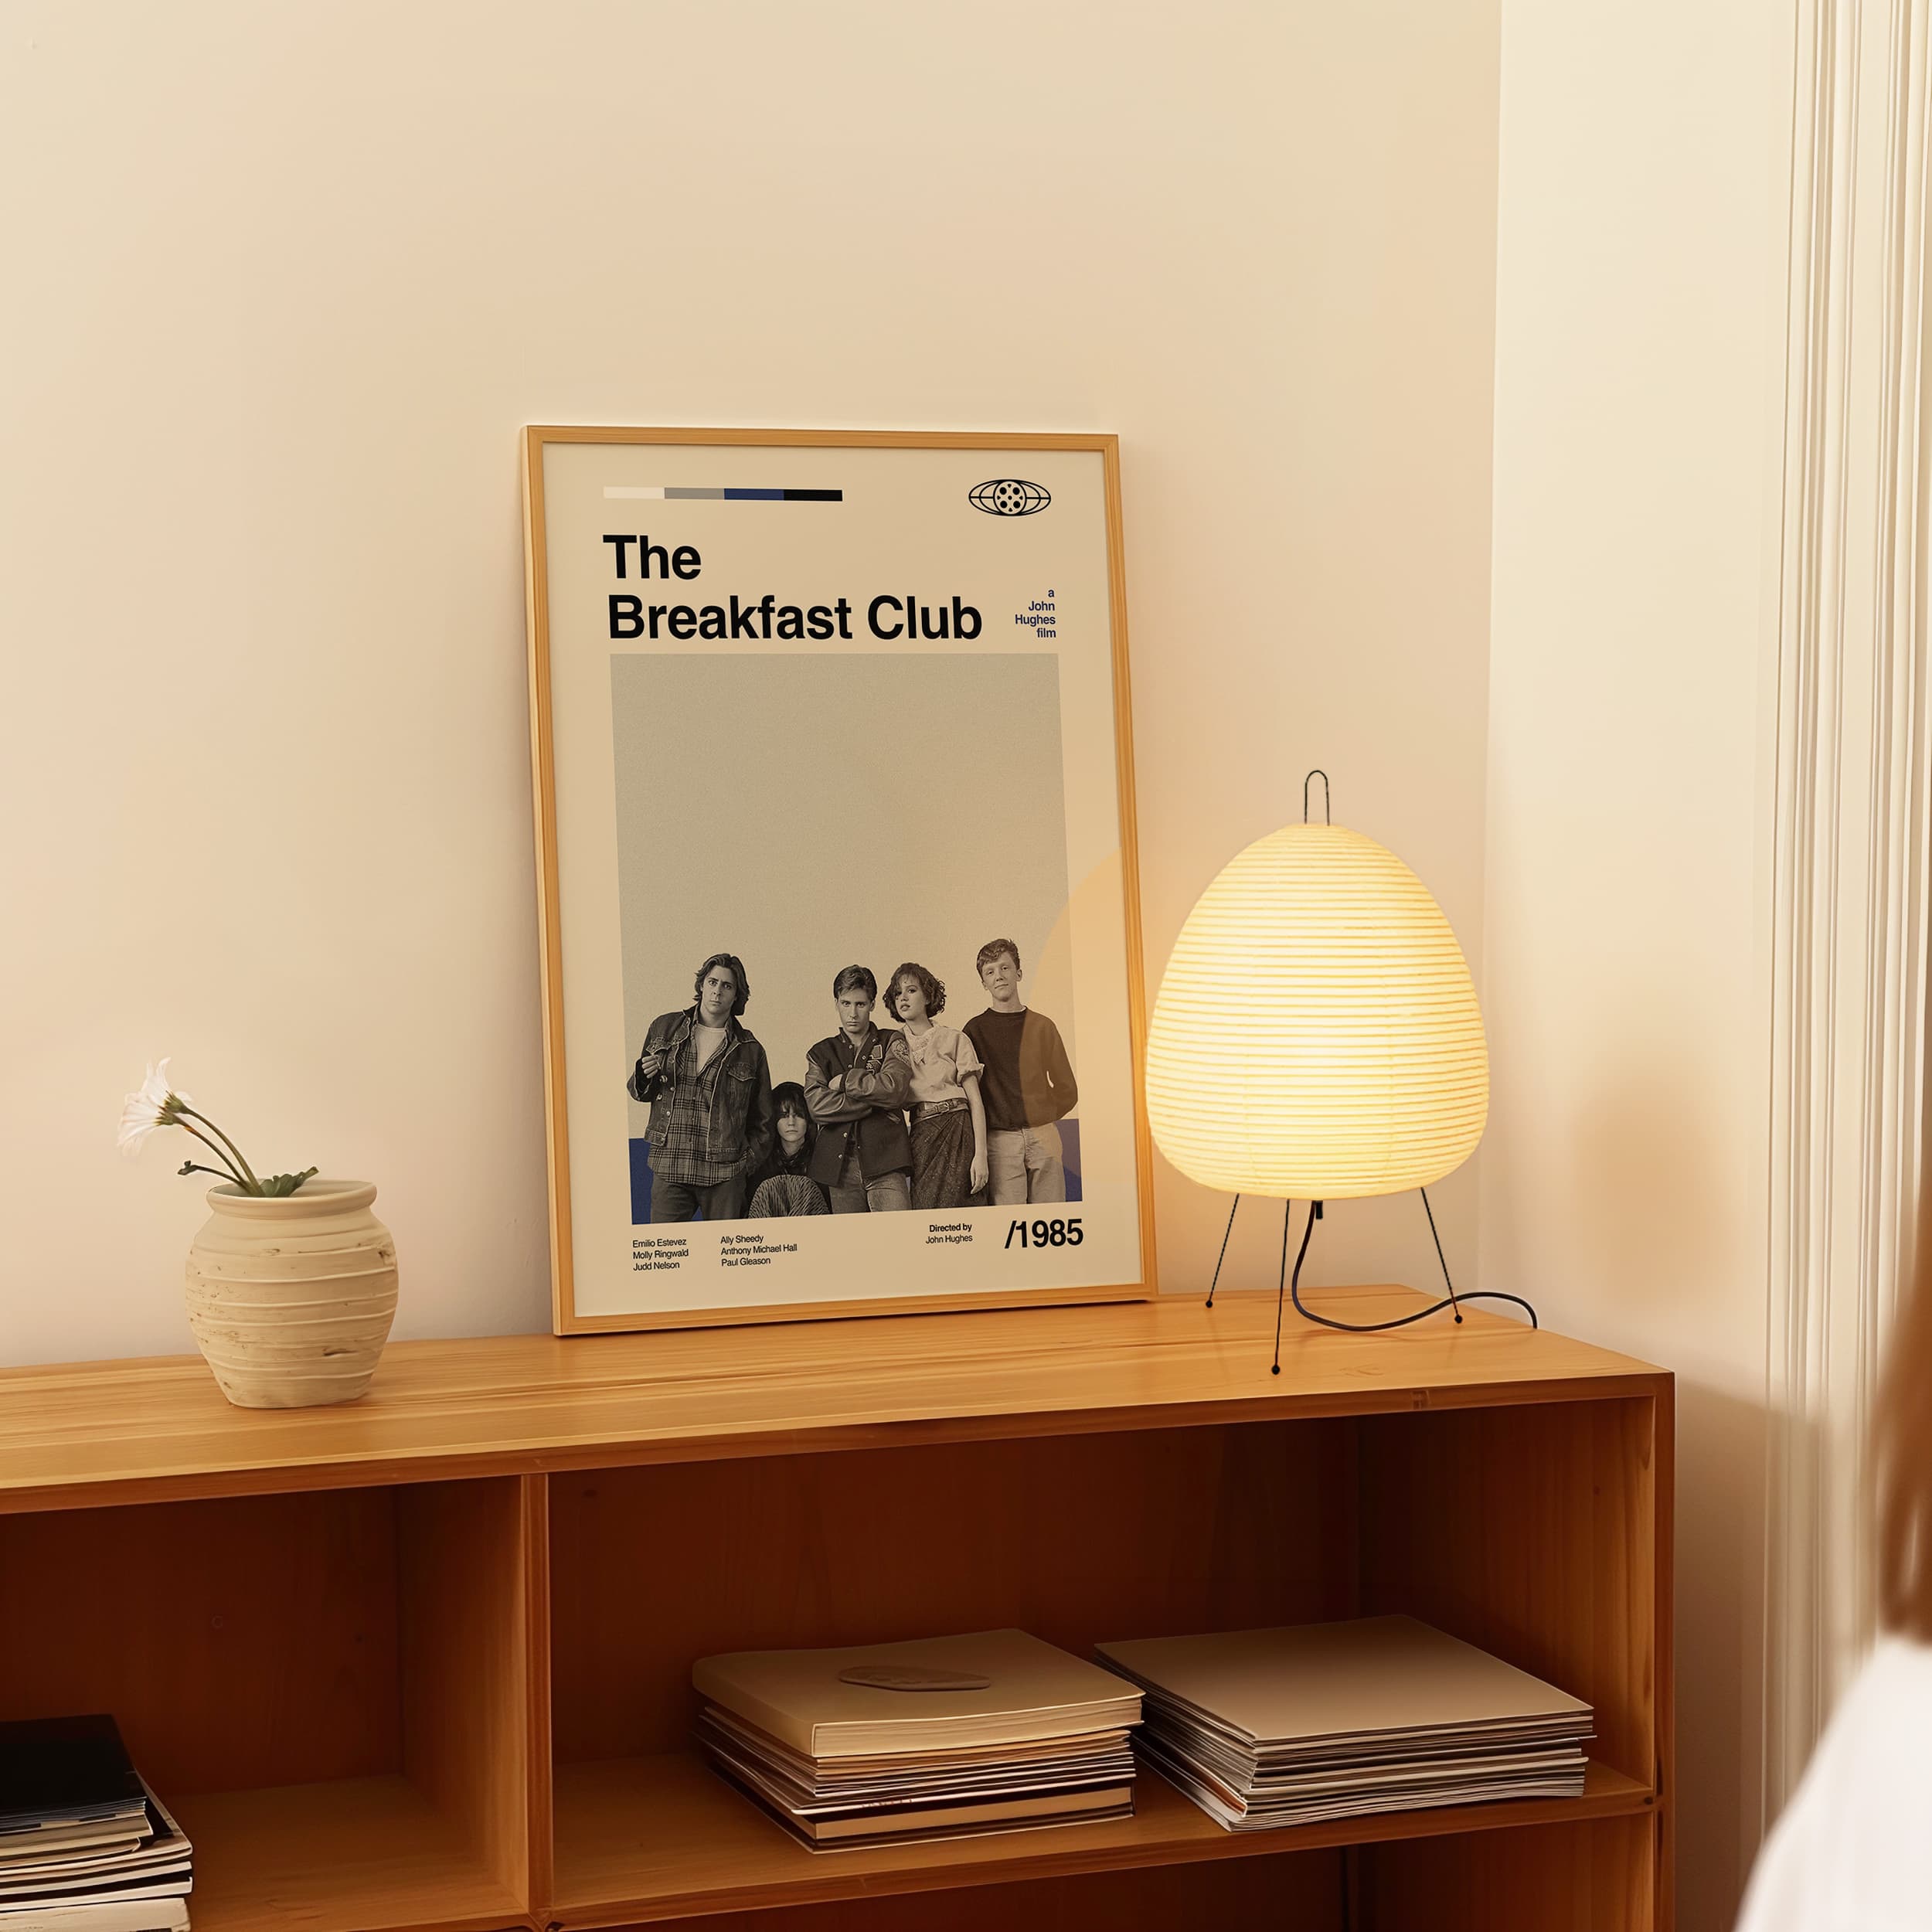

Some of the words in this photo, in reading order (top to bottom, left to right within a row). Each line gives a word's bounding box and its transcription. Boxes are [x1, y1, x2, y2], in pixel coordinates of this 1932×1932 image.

[603, 535, 701, 580] The
[1028, 600, 1056, 611] John
[609, 594, 852, 640] Breakfast
[868, 595, 982, 640] Club
[1015, 614, 1056, 627] Hughes
[1036, 628, 1057, 638] film
[929, 1223, 961, 1232] Directed
[961, 1223, 973, 1232] by
[719, 1236, 735, 1245] Ally
[735, 1234, 764, 1243] Sheedy
[944, 1234, 974, 1244] Hughes
[1005, 1219, 1083, 1249] /1985
[632, 1240, 656, 1248] Emilio
[720, 1247, 752, 1256] Anthony
[753, 1244, 782, 1253] Michael
[782, 1243, 798, 1252] Hall
[632, 1251, 654, 1260] Molly
[654, 1249, 689, 1259] Ringwald
[632, 1262, 653, 1271] Judd
[653, 1261, 680, 1270] Nelson
[721, 1258, 739, 1267] Paul
[739, 1257, 771, 1266] Gleason
